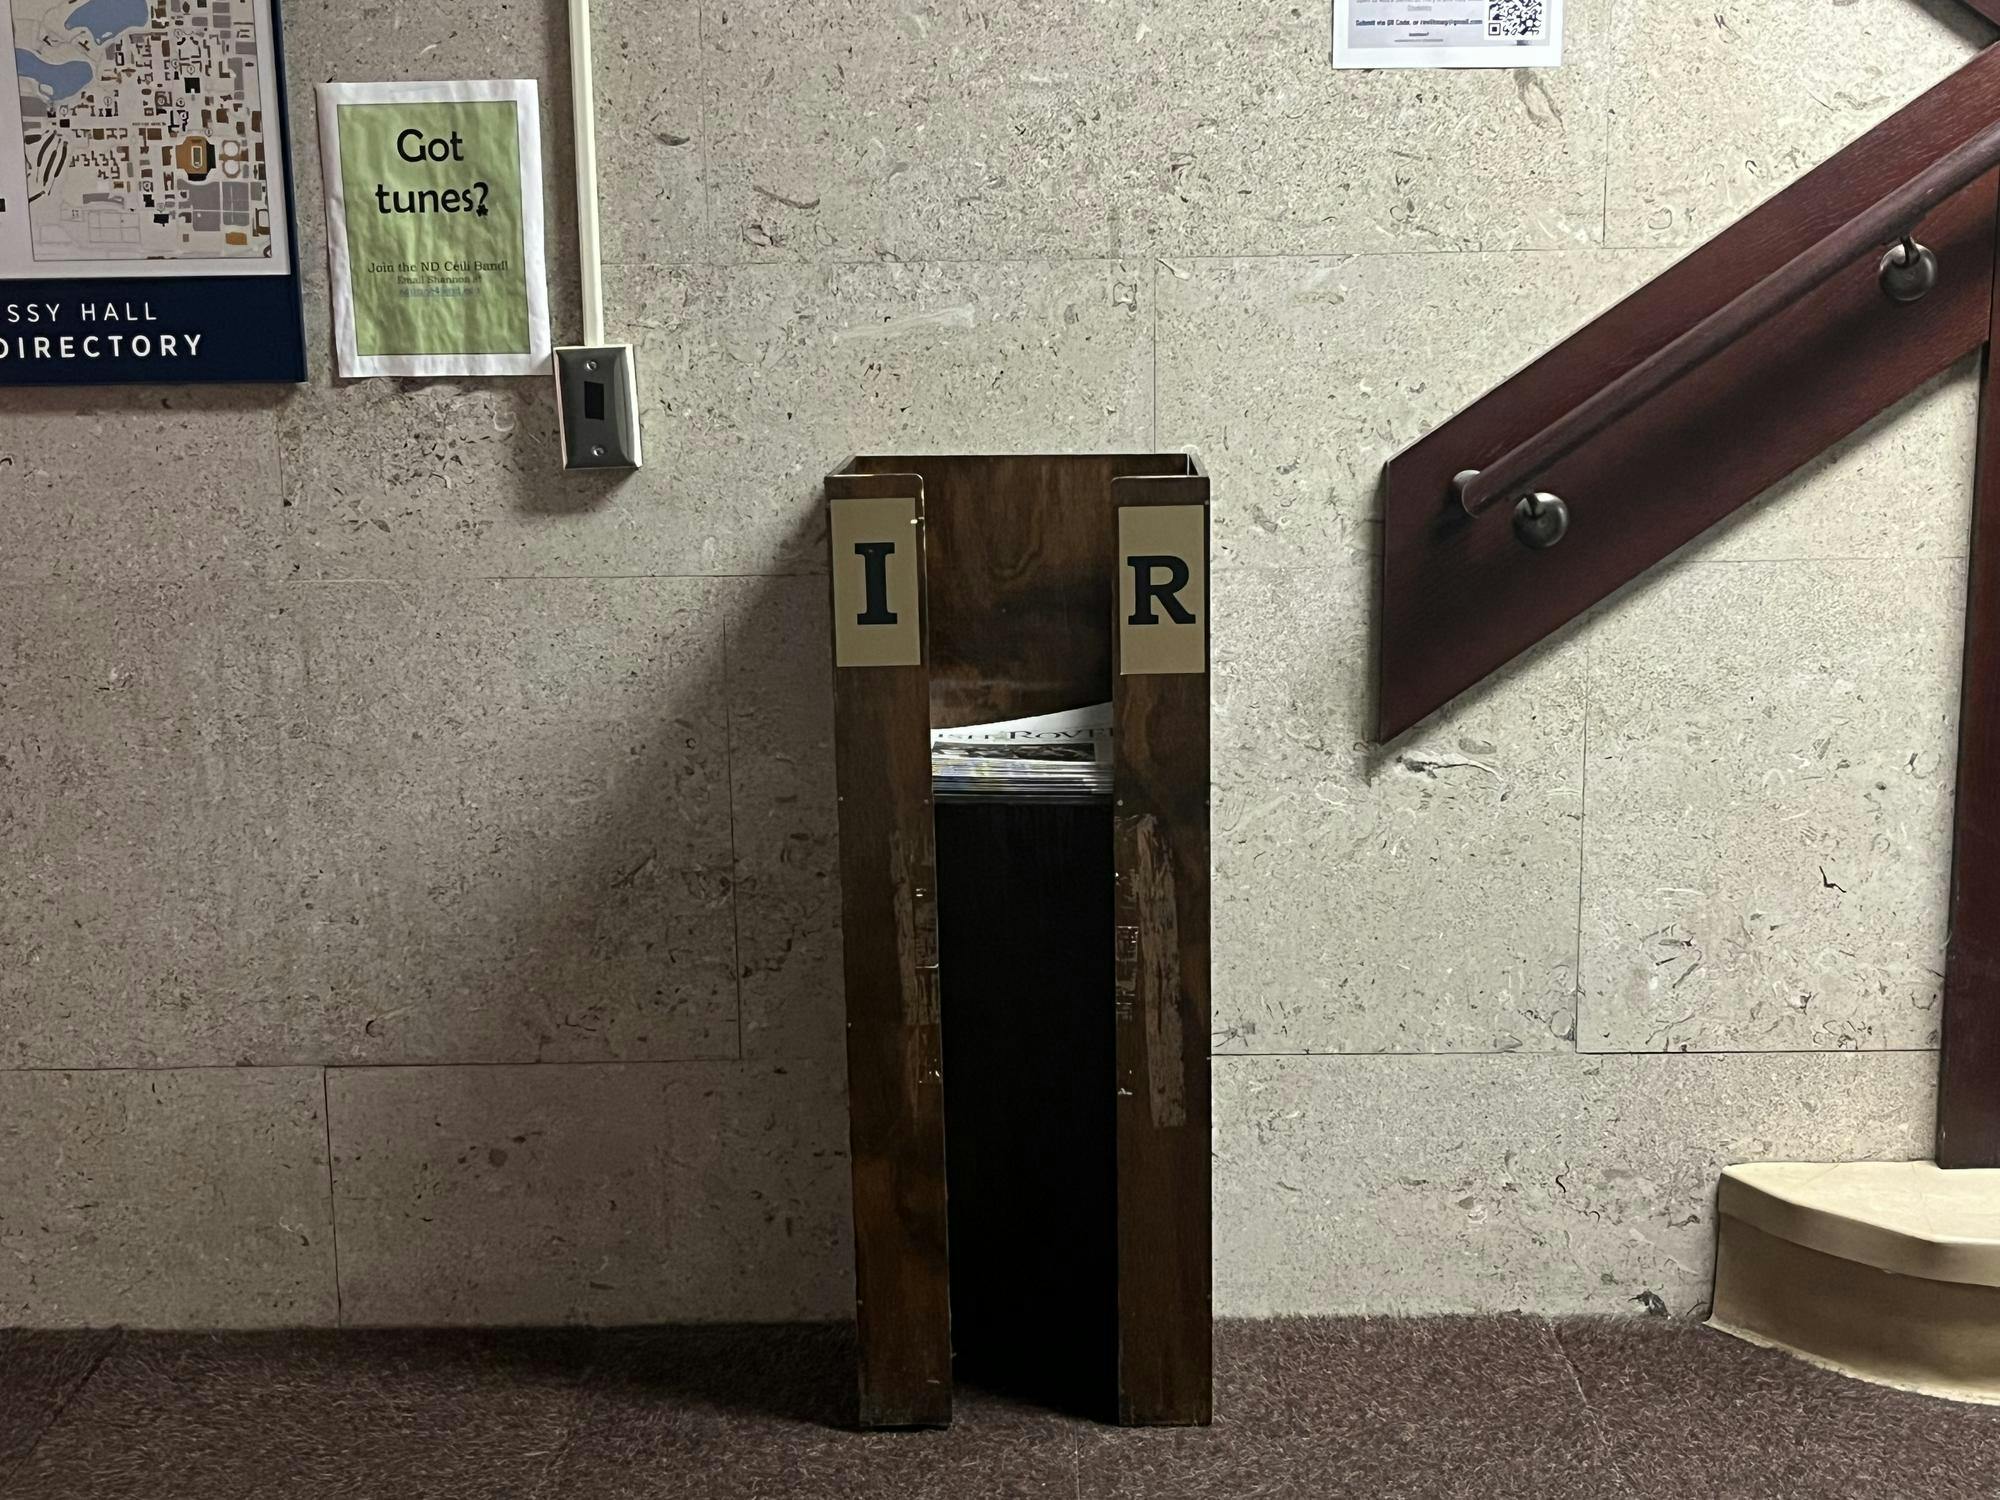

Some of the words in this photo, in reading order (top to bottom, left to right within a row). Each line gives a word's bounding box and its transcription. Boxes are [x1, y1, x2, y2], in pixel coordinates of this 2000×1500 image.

[396, 129, 465, 163] Got
[375, 181, 490, 217] tunes?
[368, 262, 395, 273] Join
[398, 262, 417, 273] the
[420, 261, 440, 272] ND
[474, 260, 509, 271] Band!
[397, 275, 425, 284] Email
[427, 275, 471, 284] Shannon
[80, 302, 158, 321] HALL
[854, 542, 898, 625] I
[1127, 555, 1197, 626] R
[1009, 727, 1114, 739] ROVE
